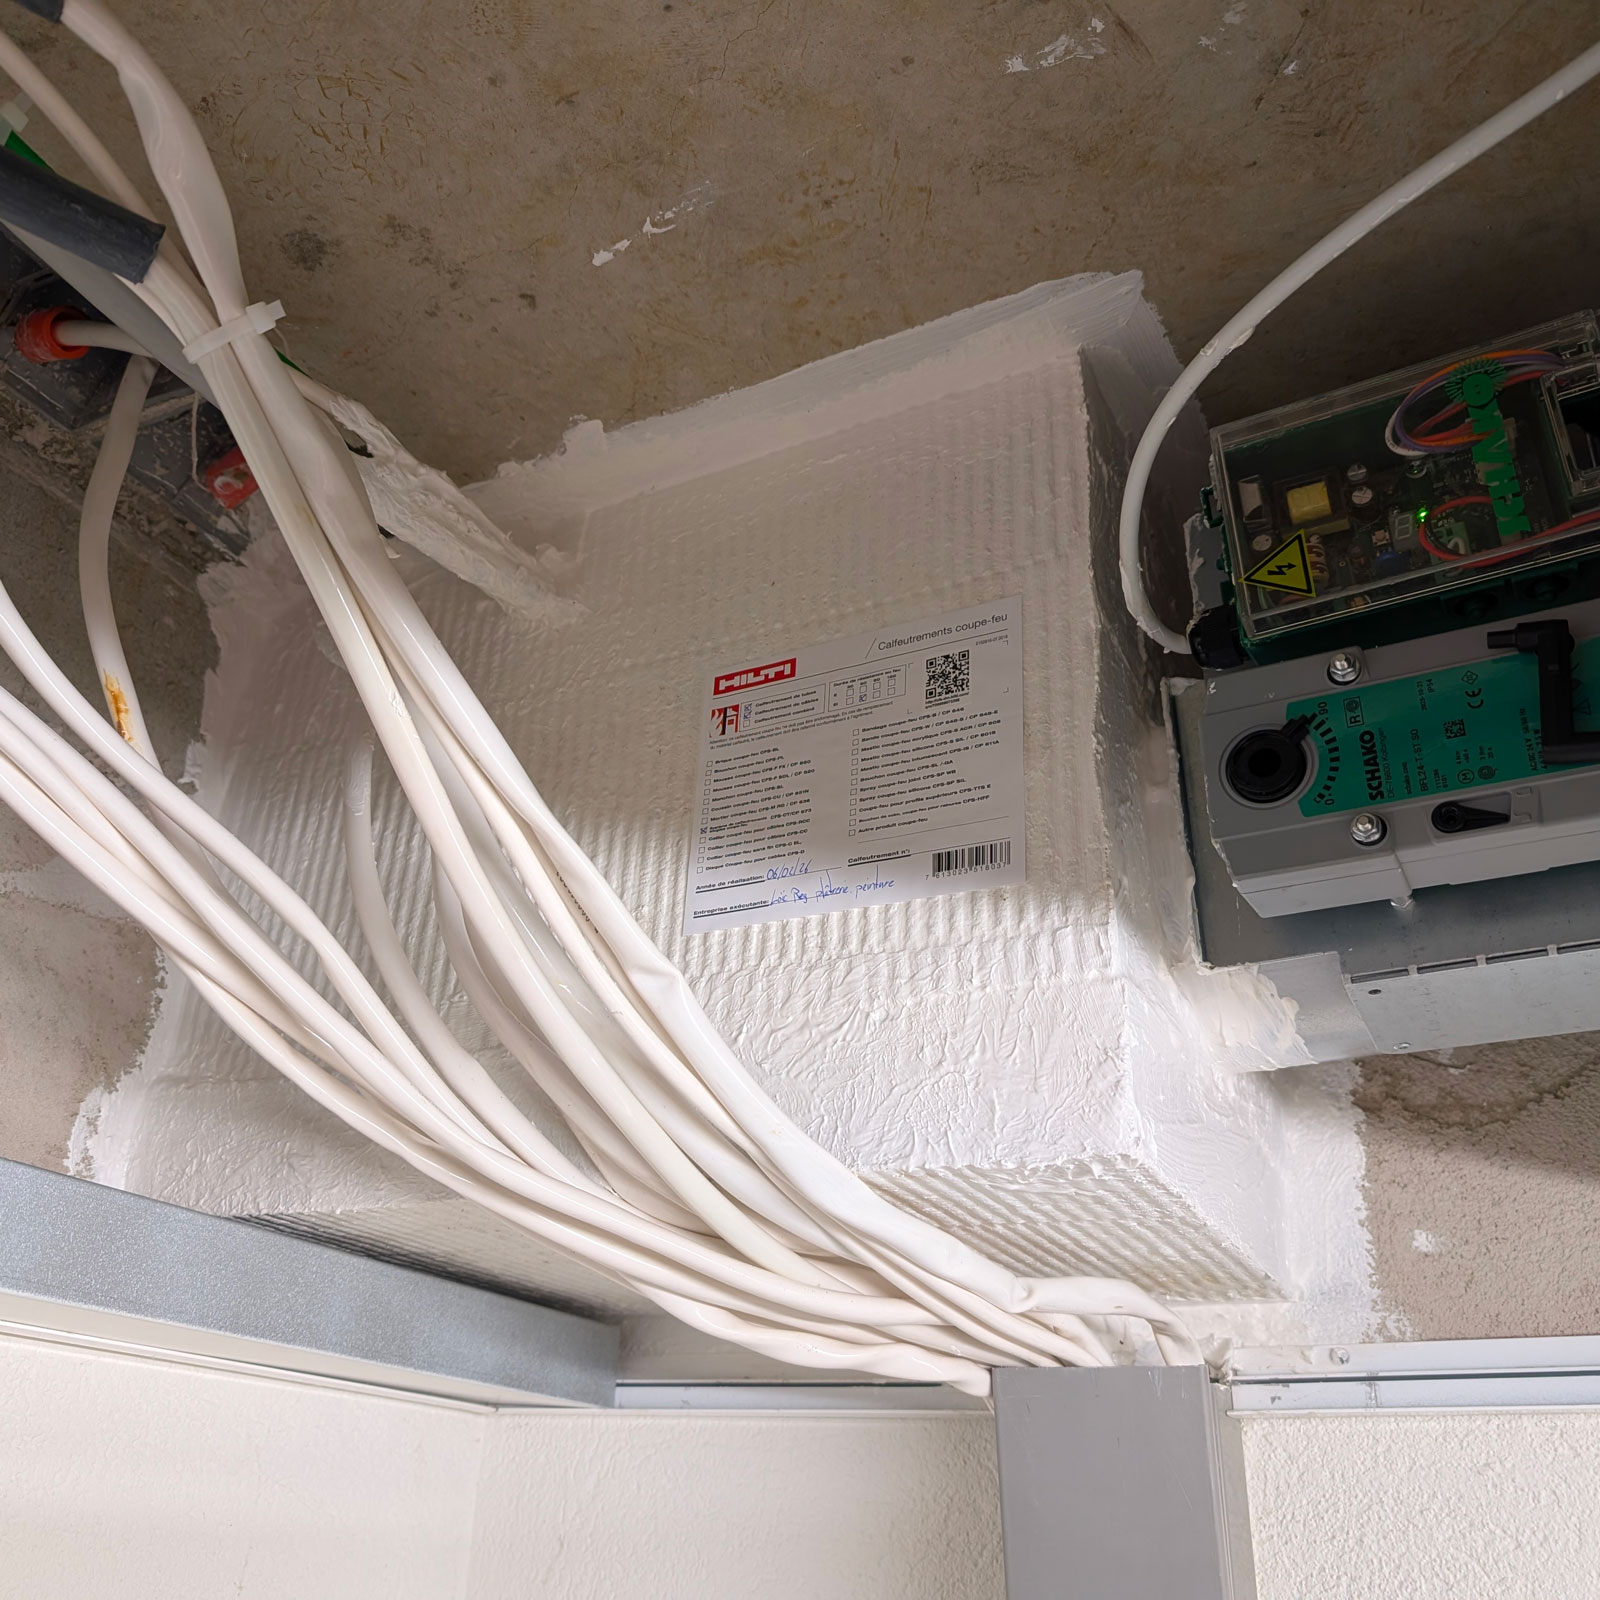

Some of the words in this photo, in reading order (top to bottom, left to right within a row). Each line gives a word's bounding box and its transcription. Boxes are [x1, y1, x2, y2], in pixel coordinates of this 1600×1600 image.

[878, 627, 952, 650] Calfeutrements
[955, 614, 1007, 632] coupe-feu
[718, 664, 791, 691] HILTI
[1425, 678, 1434, 693] IP54
[755, 695, 792, 707] Calfeutrement
[754, 704, 791, 715] Calfeutrement
[1317, 701, 1328, 715] 90
[754, 712, 791, 723] Calfeutrement
[888, 718, 917, 726] coupe-feu
[1349, 714, 1360, 724] R
[880, 729, 909, 737] coupe-feu
[881, 739, 910, 747] coupe-feu
[733, 752, 758, 760] coupe-feu
[881, 749, 910, 757] coupe-feu
[880, 759, 910, 767] coupe-feu
[1359, 730, 1384, 800] SCHAKO
[1412, 742, 1428, 791] BFL24-T-ST
[886, 768, 915, 776] coupe-feu
[1461, 772, 1471, 782] M
[877, 780, 906, 788] coupe-feu
[897, 818, 927, 826] coupe-feu
[848, 850, 898, 862] Calfeutrement
[934, 867, 968, 878] 613023
[973, 860, 1008, 872] 518037
[727, 875, 764, 884] réalisation:
[693, 907, 727, 917] Entreprise
[729, 900, 768, 911] exécutante:
